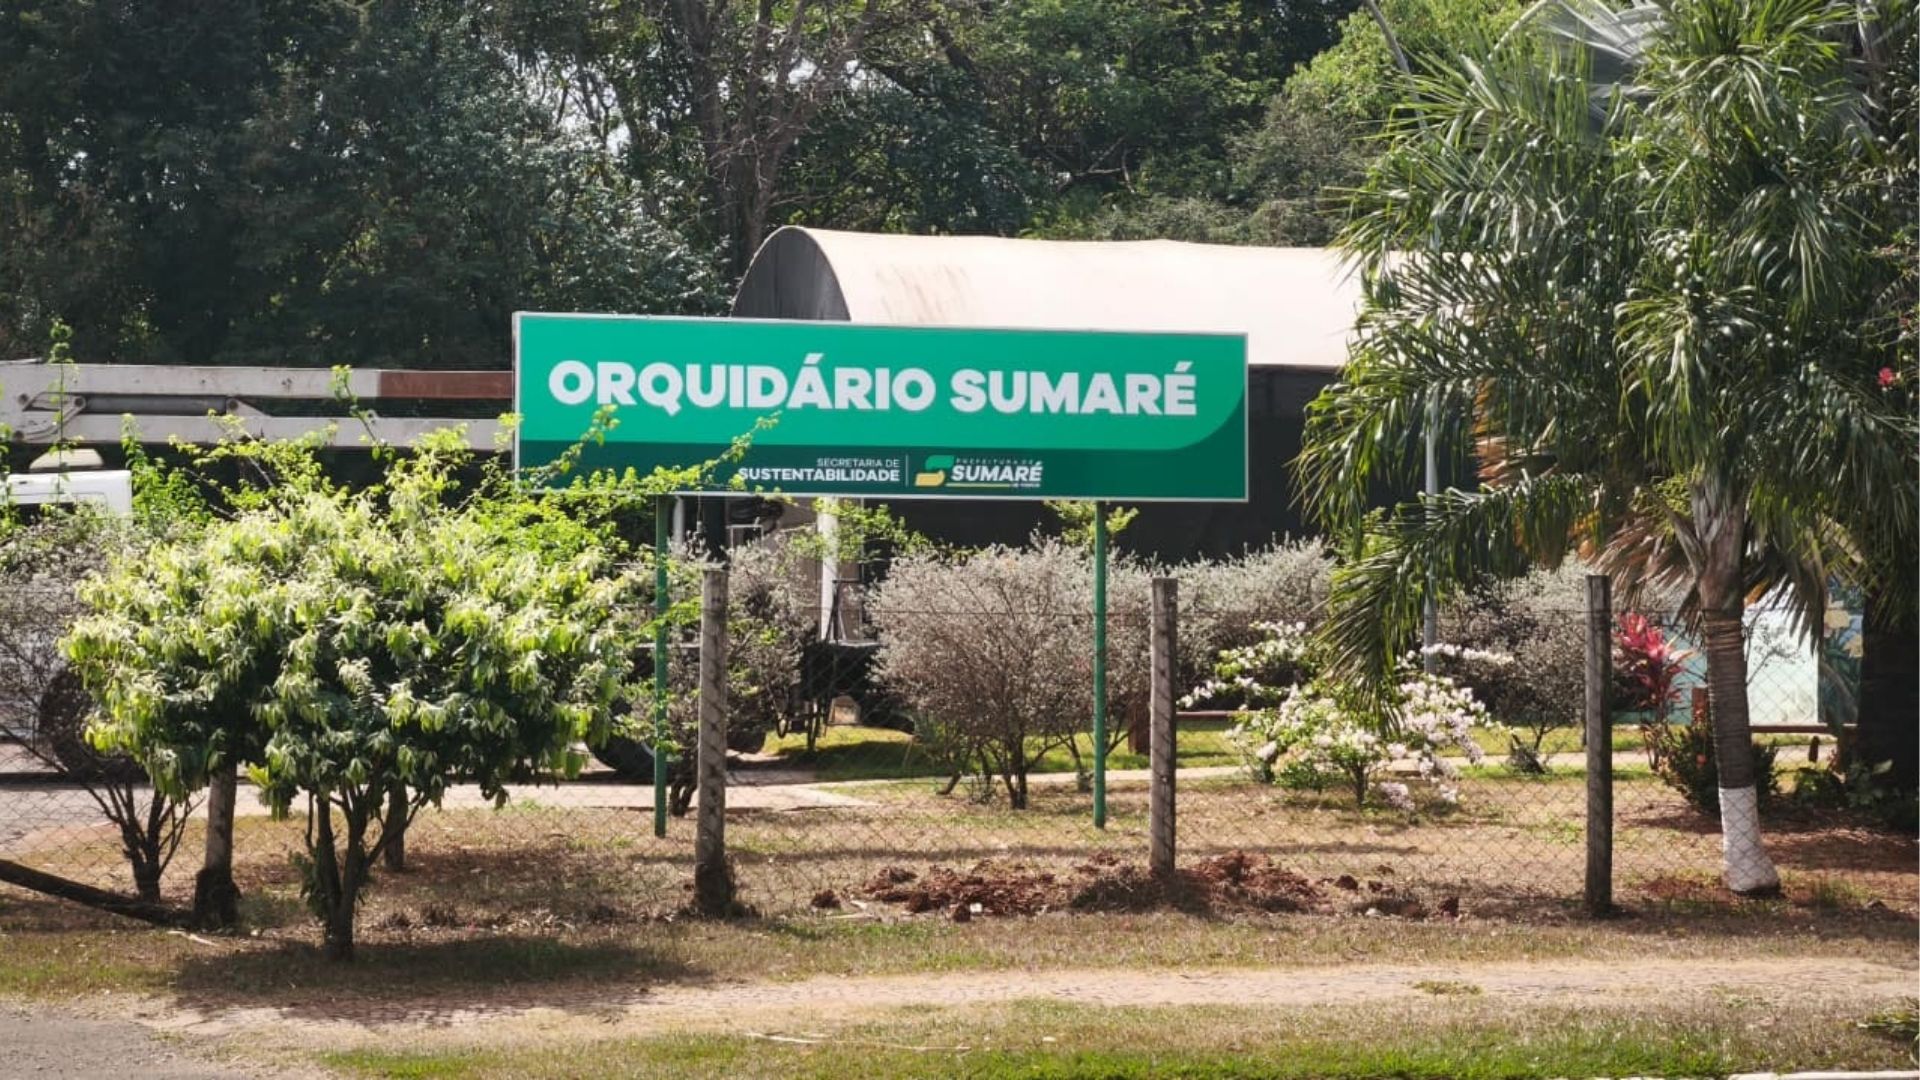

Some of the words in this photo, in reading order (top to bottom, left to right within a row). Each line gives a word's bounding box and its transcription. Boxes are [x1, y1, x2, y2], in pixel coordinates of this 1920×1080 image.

[548, 352, 937, 416] ORQUIDÁRIO
[950, 361, 1197, 416] SUMARÉ
[816, 457, 883, 469] SECRETARIA
[885, 458, 900, 469] DE
[951, 460, 1043, 482] SUMARÉ
[737, 467, 901, 482] SUSTENTABILIDADE
